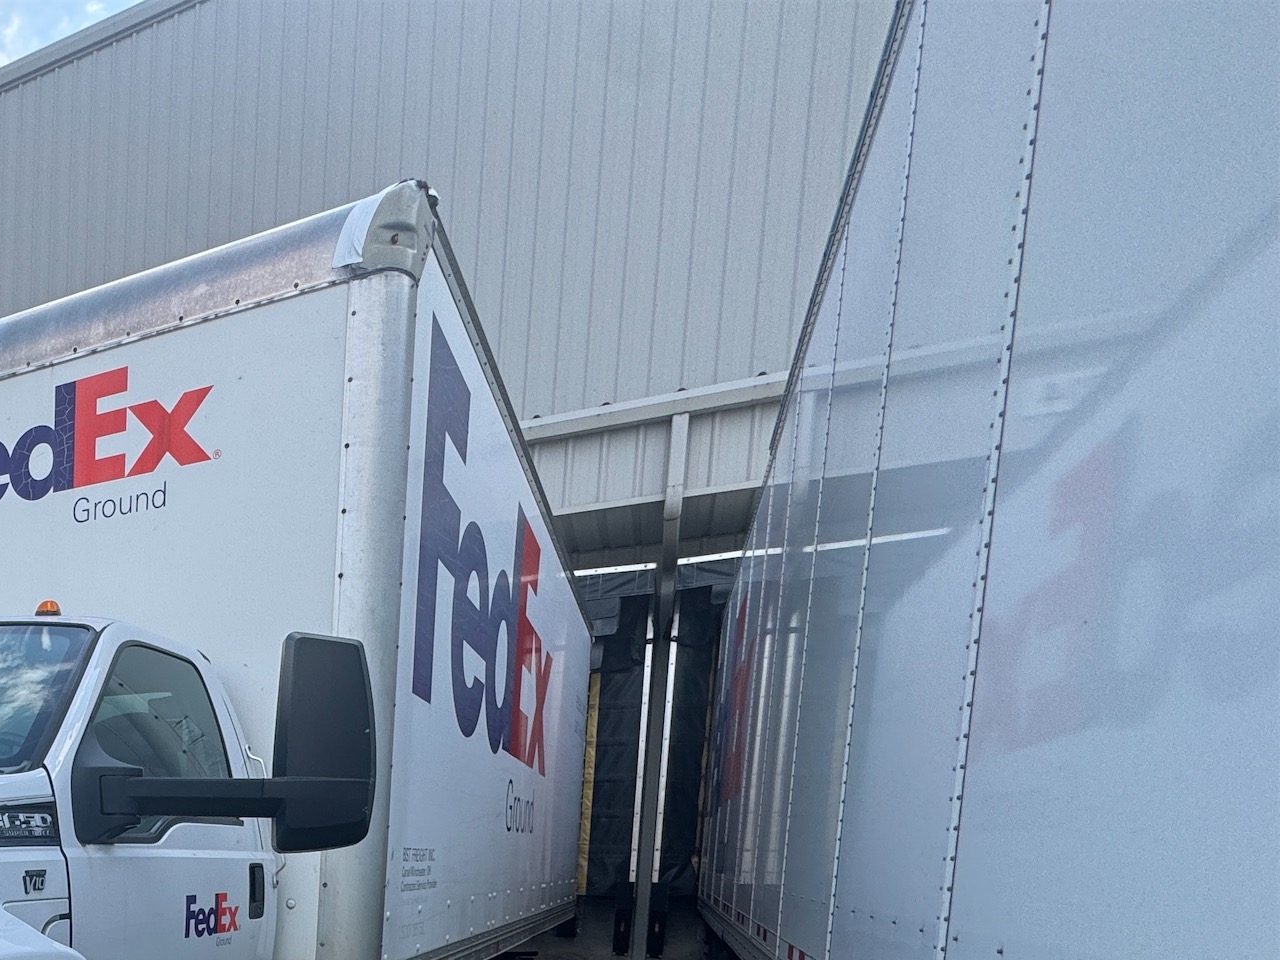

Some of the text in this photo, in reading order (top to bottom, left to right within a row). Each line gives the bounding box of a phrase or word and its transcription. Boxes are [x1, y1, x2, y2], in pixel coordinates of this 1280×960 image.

[72, 482, 167, 523] Ground
[412, 311, 547, 777] FedEx
[504, 778, 535, 834] Ground
[22, 875, 46, 895] V10
[184, 893, 239, 938] FedEx
